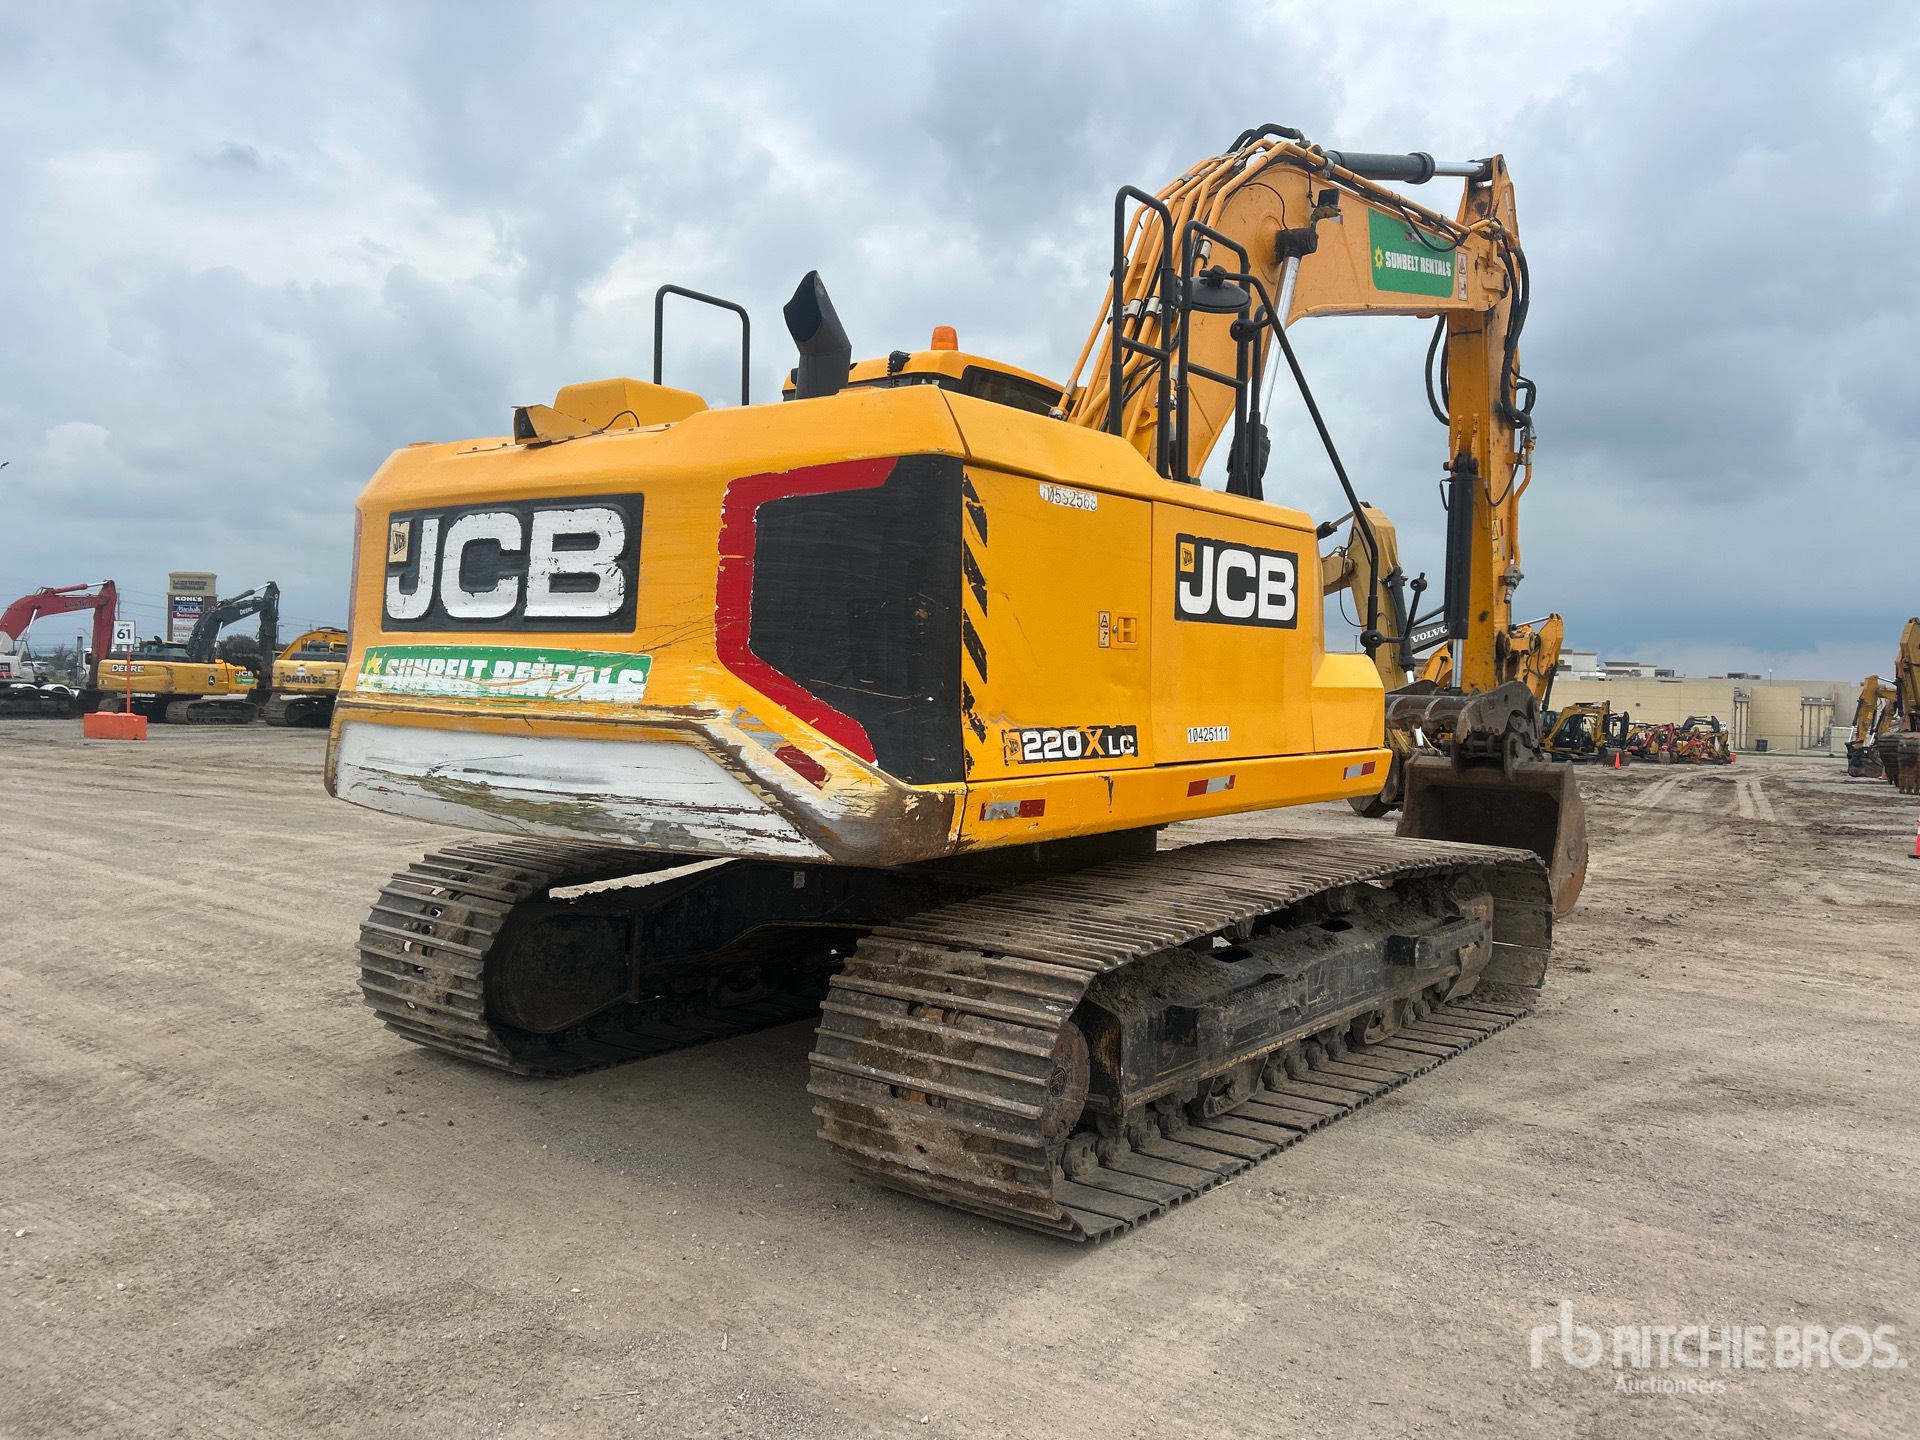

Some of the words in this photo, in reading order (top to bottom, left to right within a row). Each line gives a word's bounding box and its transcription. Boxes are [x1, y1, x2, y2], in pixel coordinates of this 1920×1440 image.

[1385, 251, 1419, 272] SUNBELT
[1420, 257, 1451, 277] RENTALS
[386, 507, 626, 619] JCB
[1179, 545, 1296, 621] JCB
[239, 607, 254, 615] DEERE
[117, 629, 131, 640] 61
[111, 664, 145, 673] DEERE
[1188, 726, 1229, 743] 10425111
